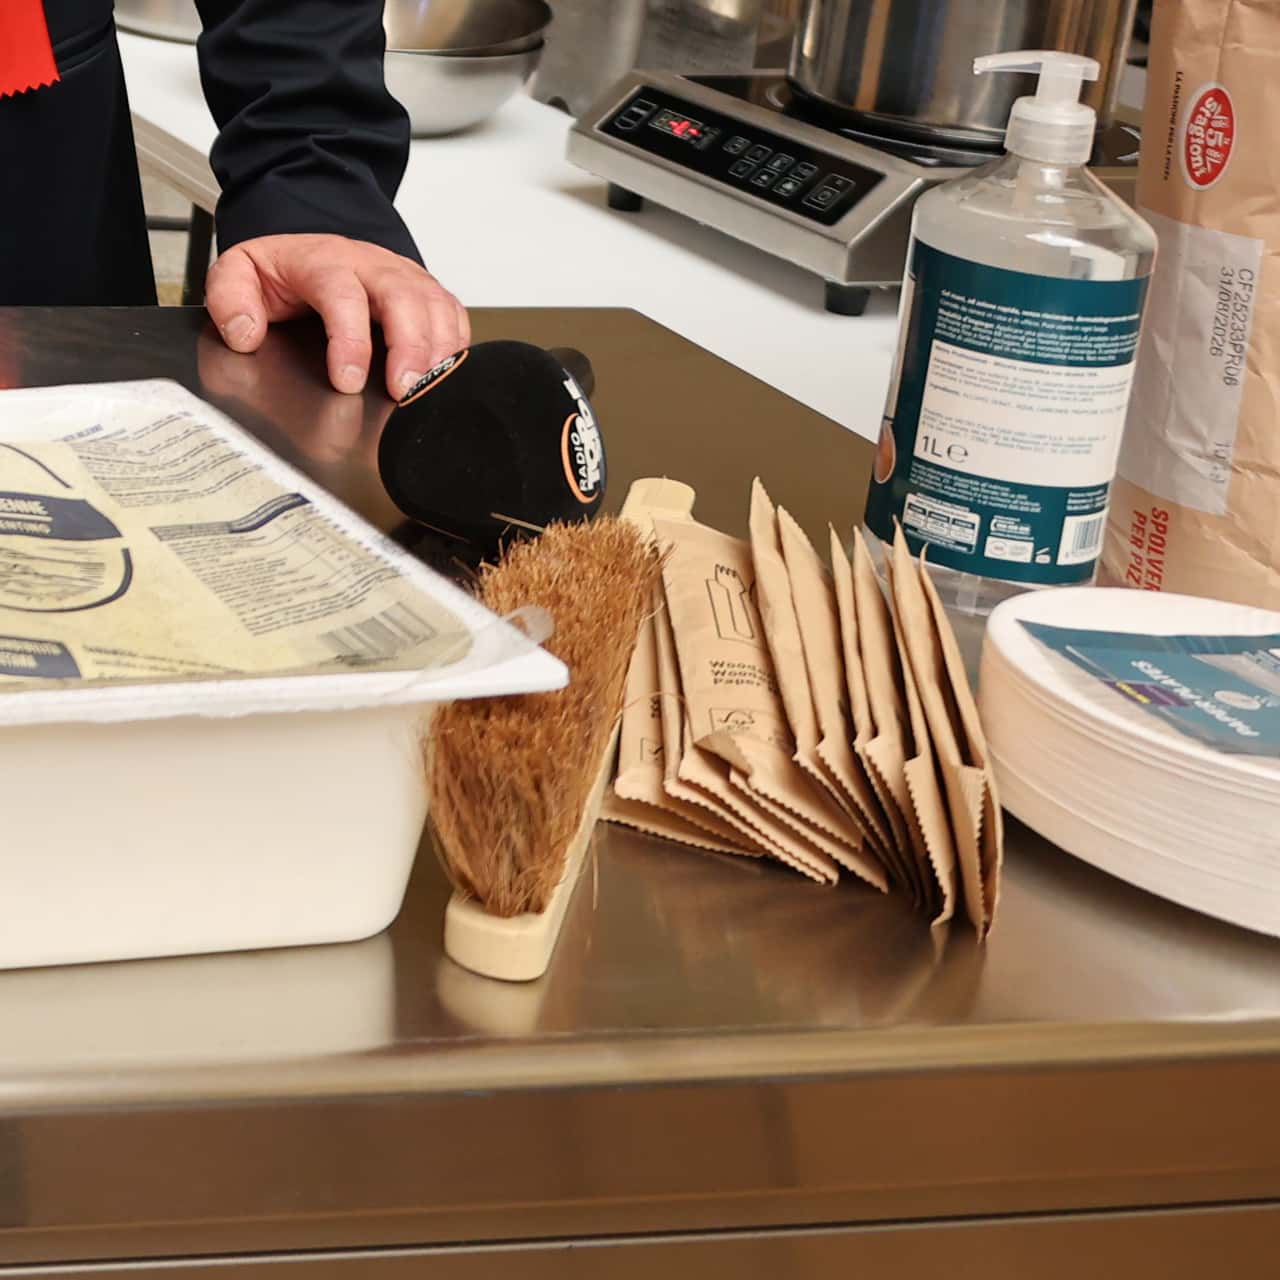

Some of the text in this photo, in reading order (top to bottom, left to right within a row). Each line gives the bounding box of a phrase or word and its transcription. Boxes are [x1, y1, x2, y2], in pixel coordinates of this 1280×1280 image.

[1206, 128, 1224, 147] 5
[1209, 266, 1234, 357] 31/08/2026
[571, 431, 589, 491] RADIO
[923, 435, 943, 457] 1L
[1129, 509, 1148, 549] PER
